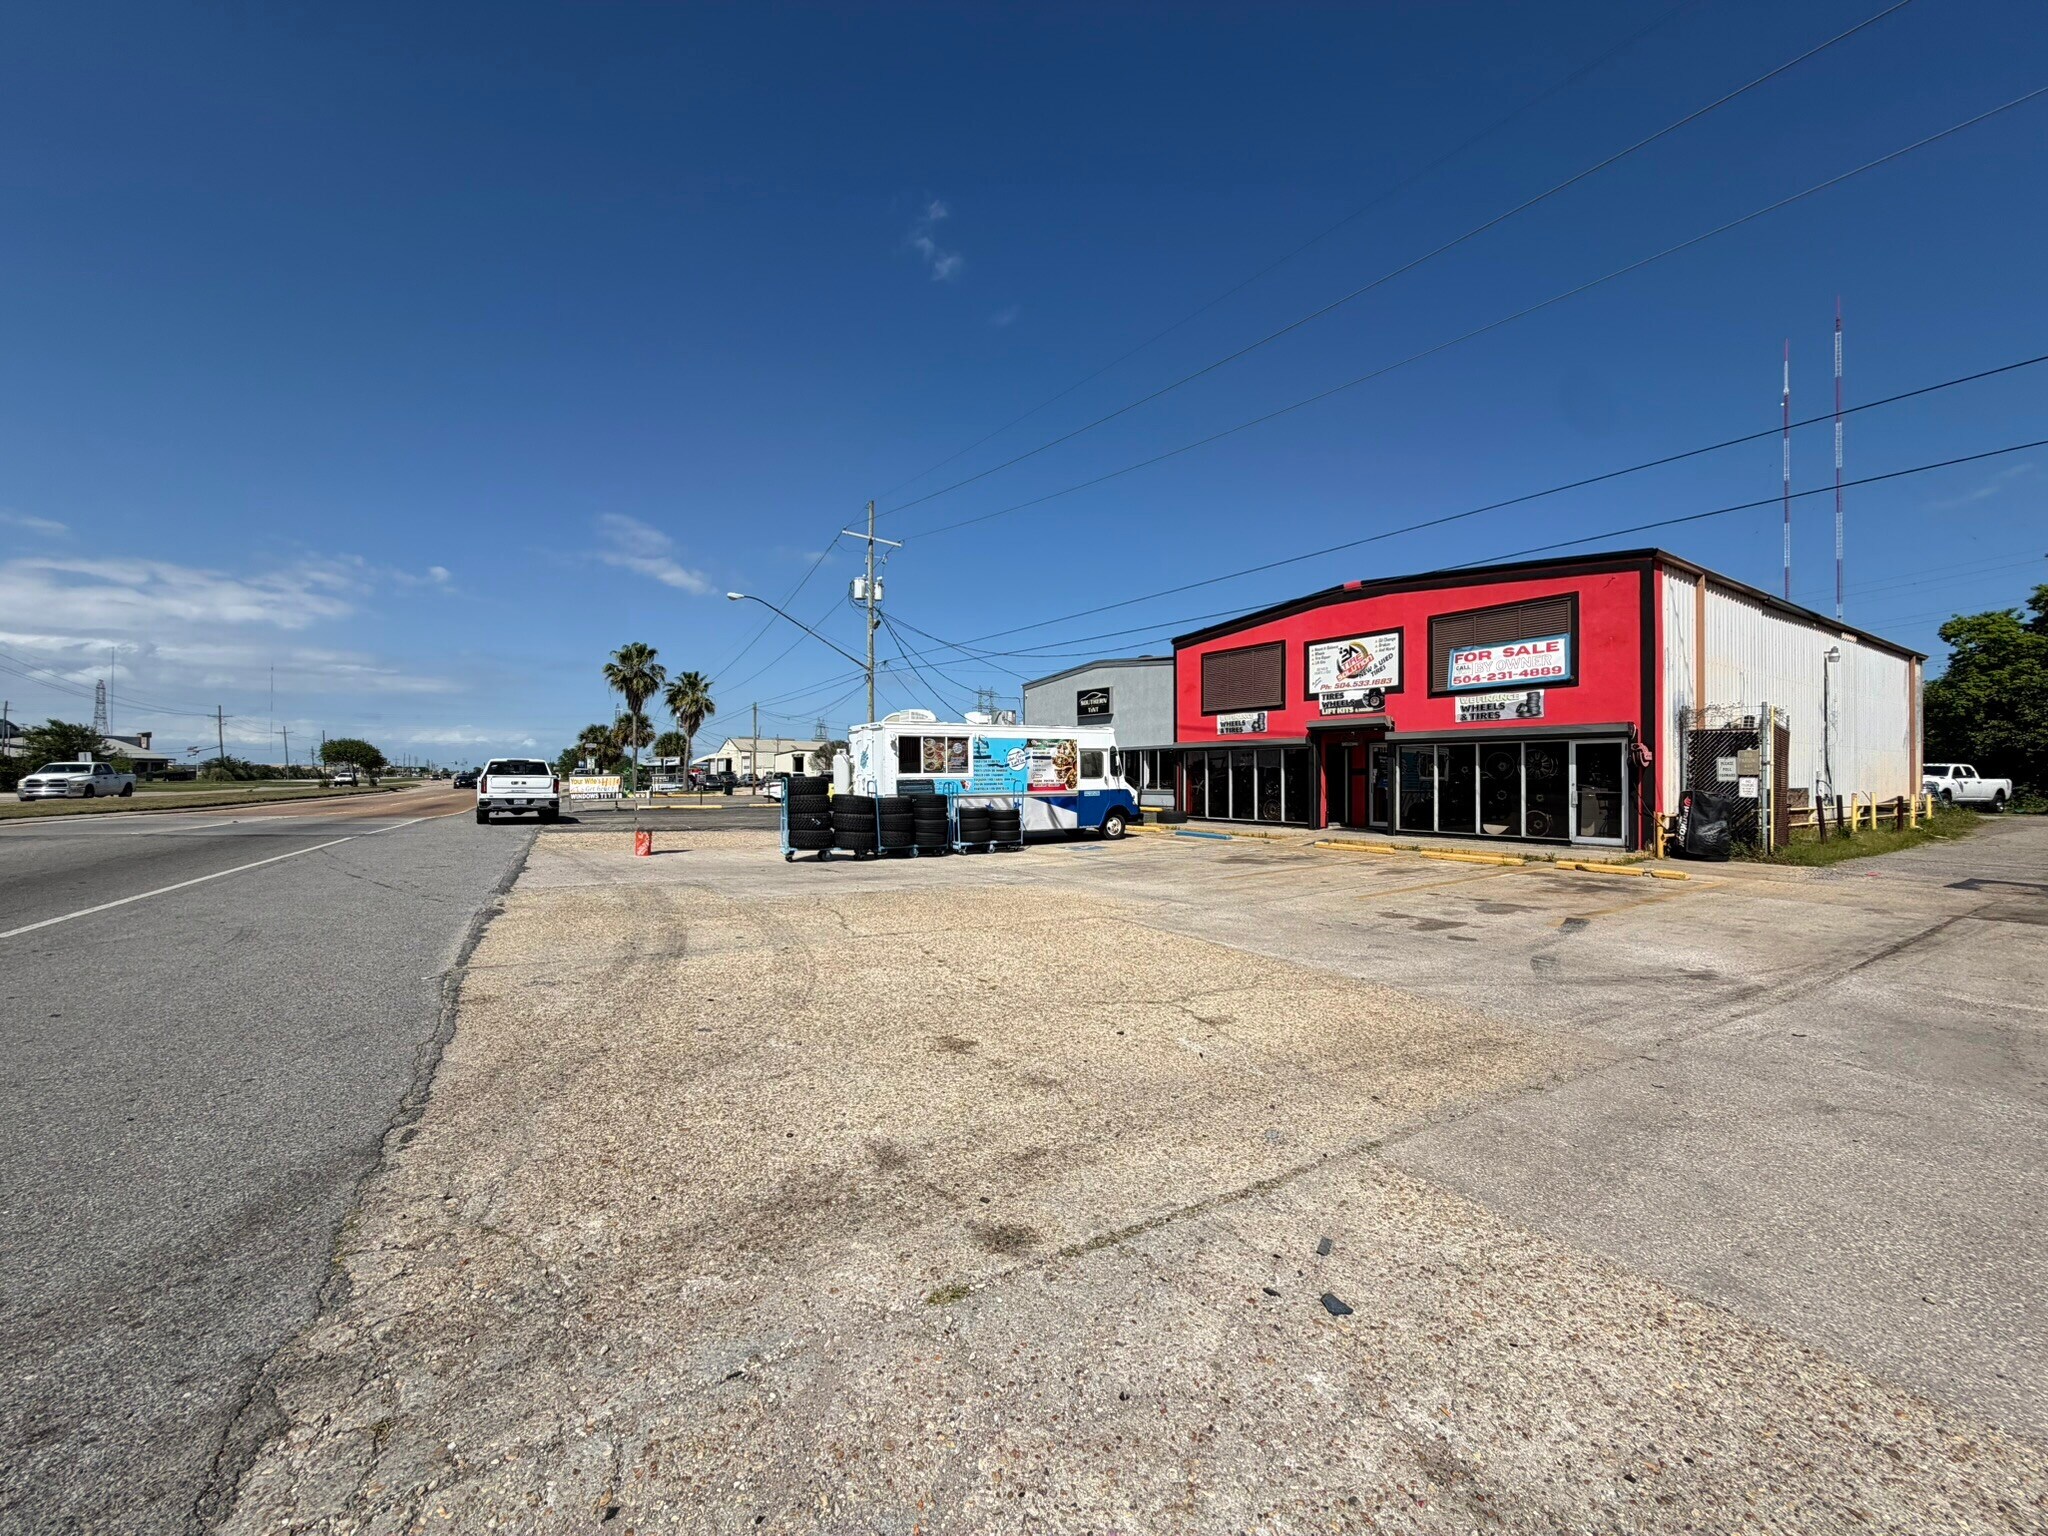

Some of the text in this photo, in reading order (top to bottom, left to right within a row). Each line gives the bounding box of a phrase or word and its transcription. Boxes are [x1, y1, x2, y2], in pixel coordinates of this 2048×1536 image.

[1455, 641, 1560, 663] FOR SALE
[1341, 653, 1364, 670] TIRE
[1359, 665, 1372, 678] NEW
[1378, 653, 1394, 666] USED
[1475, 654, 1553, 673] BY OWNER
[1371, 665, 1386, 677] TIRES
[1453, 665, 1562, 685] 504-231-4889
[1322, 692, 1344, 700] TIRES
[1322, 699, 1355, 709] WHEELS
[1337, 706, 1353, 714] KITS
[1460, 702, 1505, 713] WHEELS
[1469, 711, 1501, 720] TIRES
